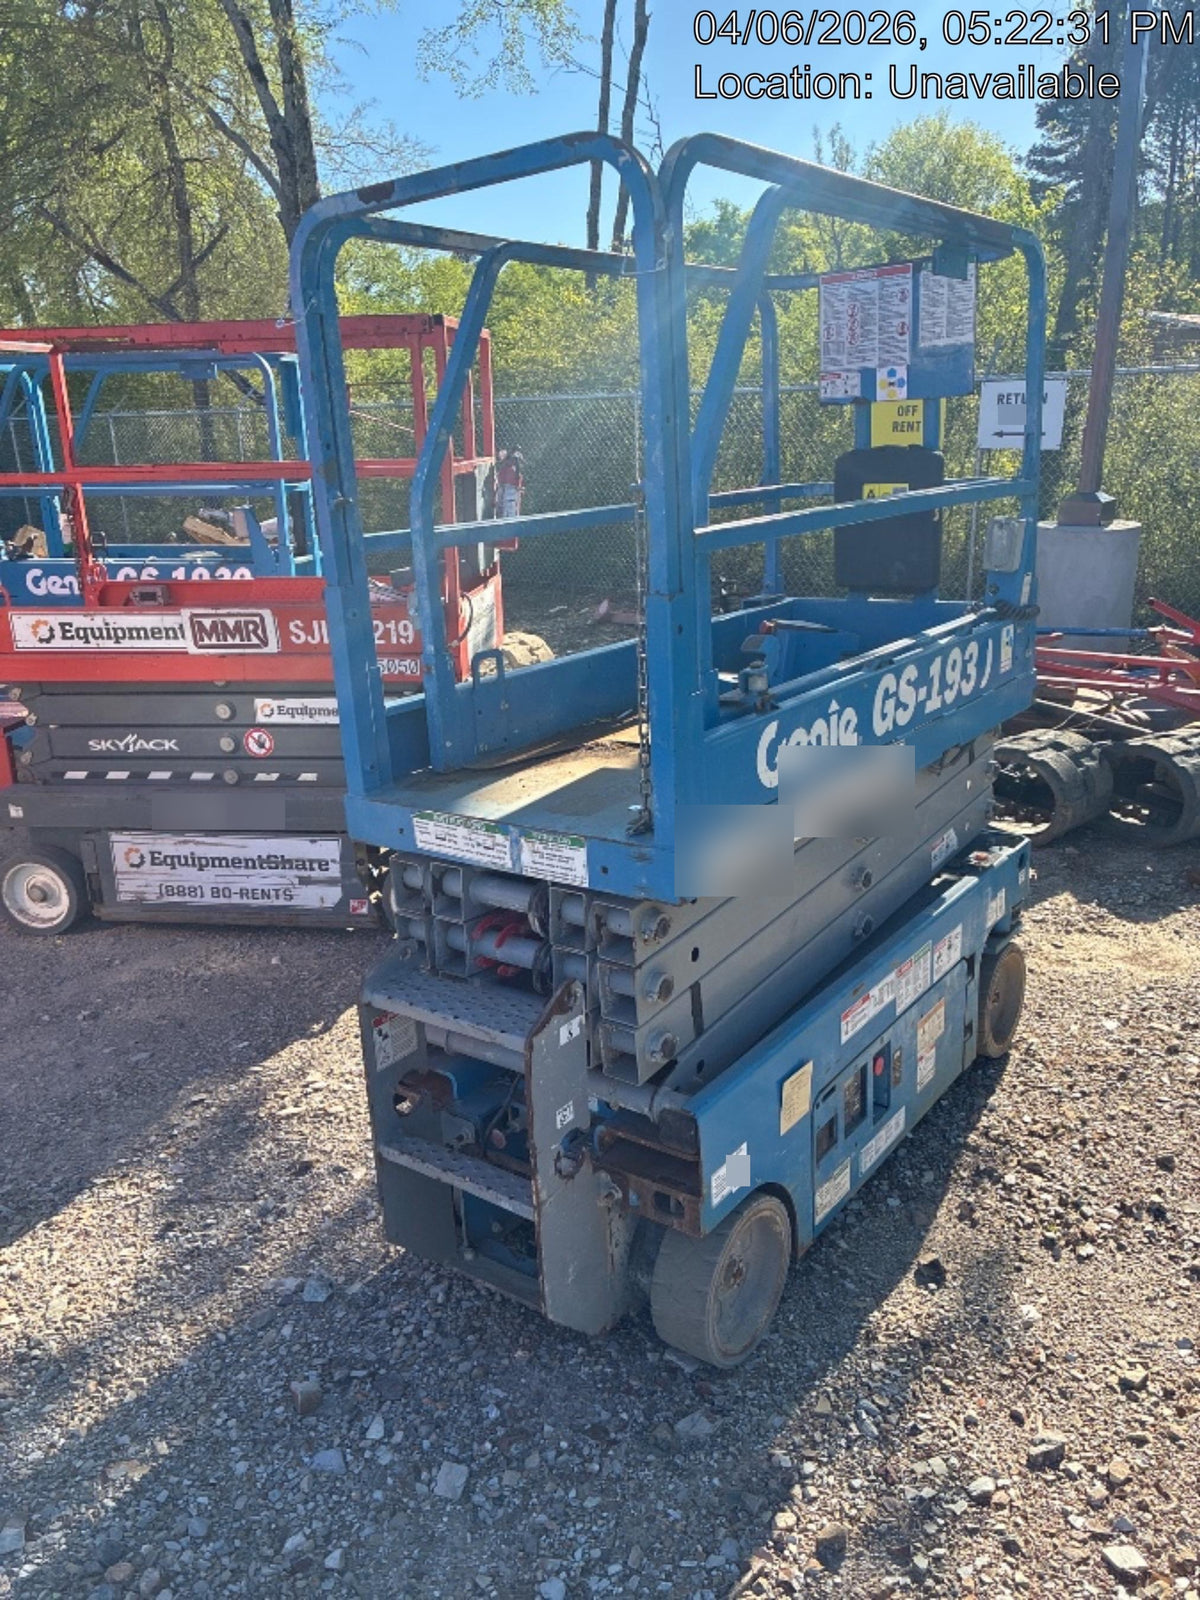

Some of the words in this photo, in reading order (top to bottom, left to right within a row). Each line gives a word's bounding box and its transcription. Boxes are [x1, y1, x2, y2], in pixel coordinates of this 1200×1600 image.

[997, 391, 1048, 405] RETUN
[897, 404, 919, 417] OFF
[892, 420, 922, 433] RENT
[25, 568, 82, 596] Gen
[194, 620, 261, 643] MMR
[372, 619, 414, 645] 219
[88, 733, 180, 753] SKYJACK
[149, 851, 330, 872] EquipmentShare
[158, 885, 205, 899] (888)
